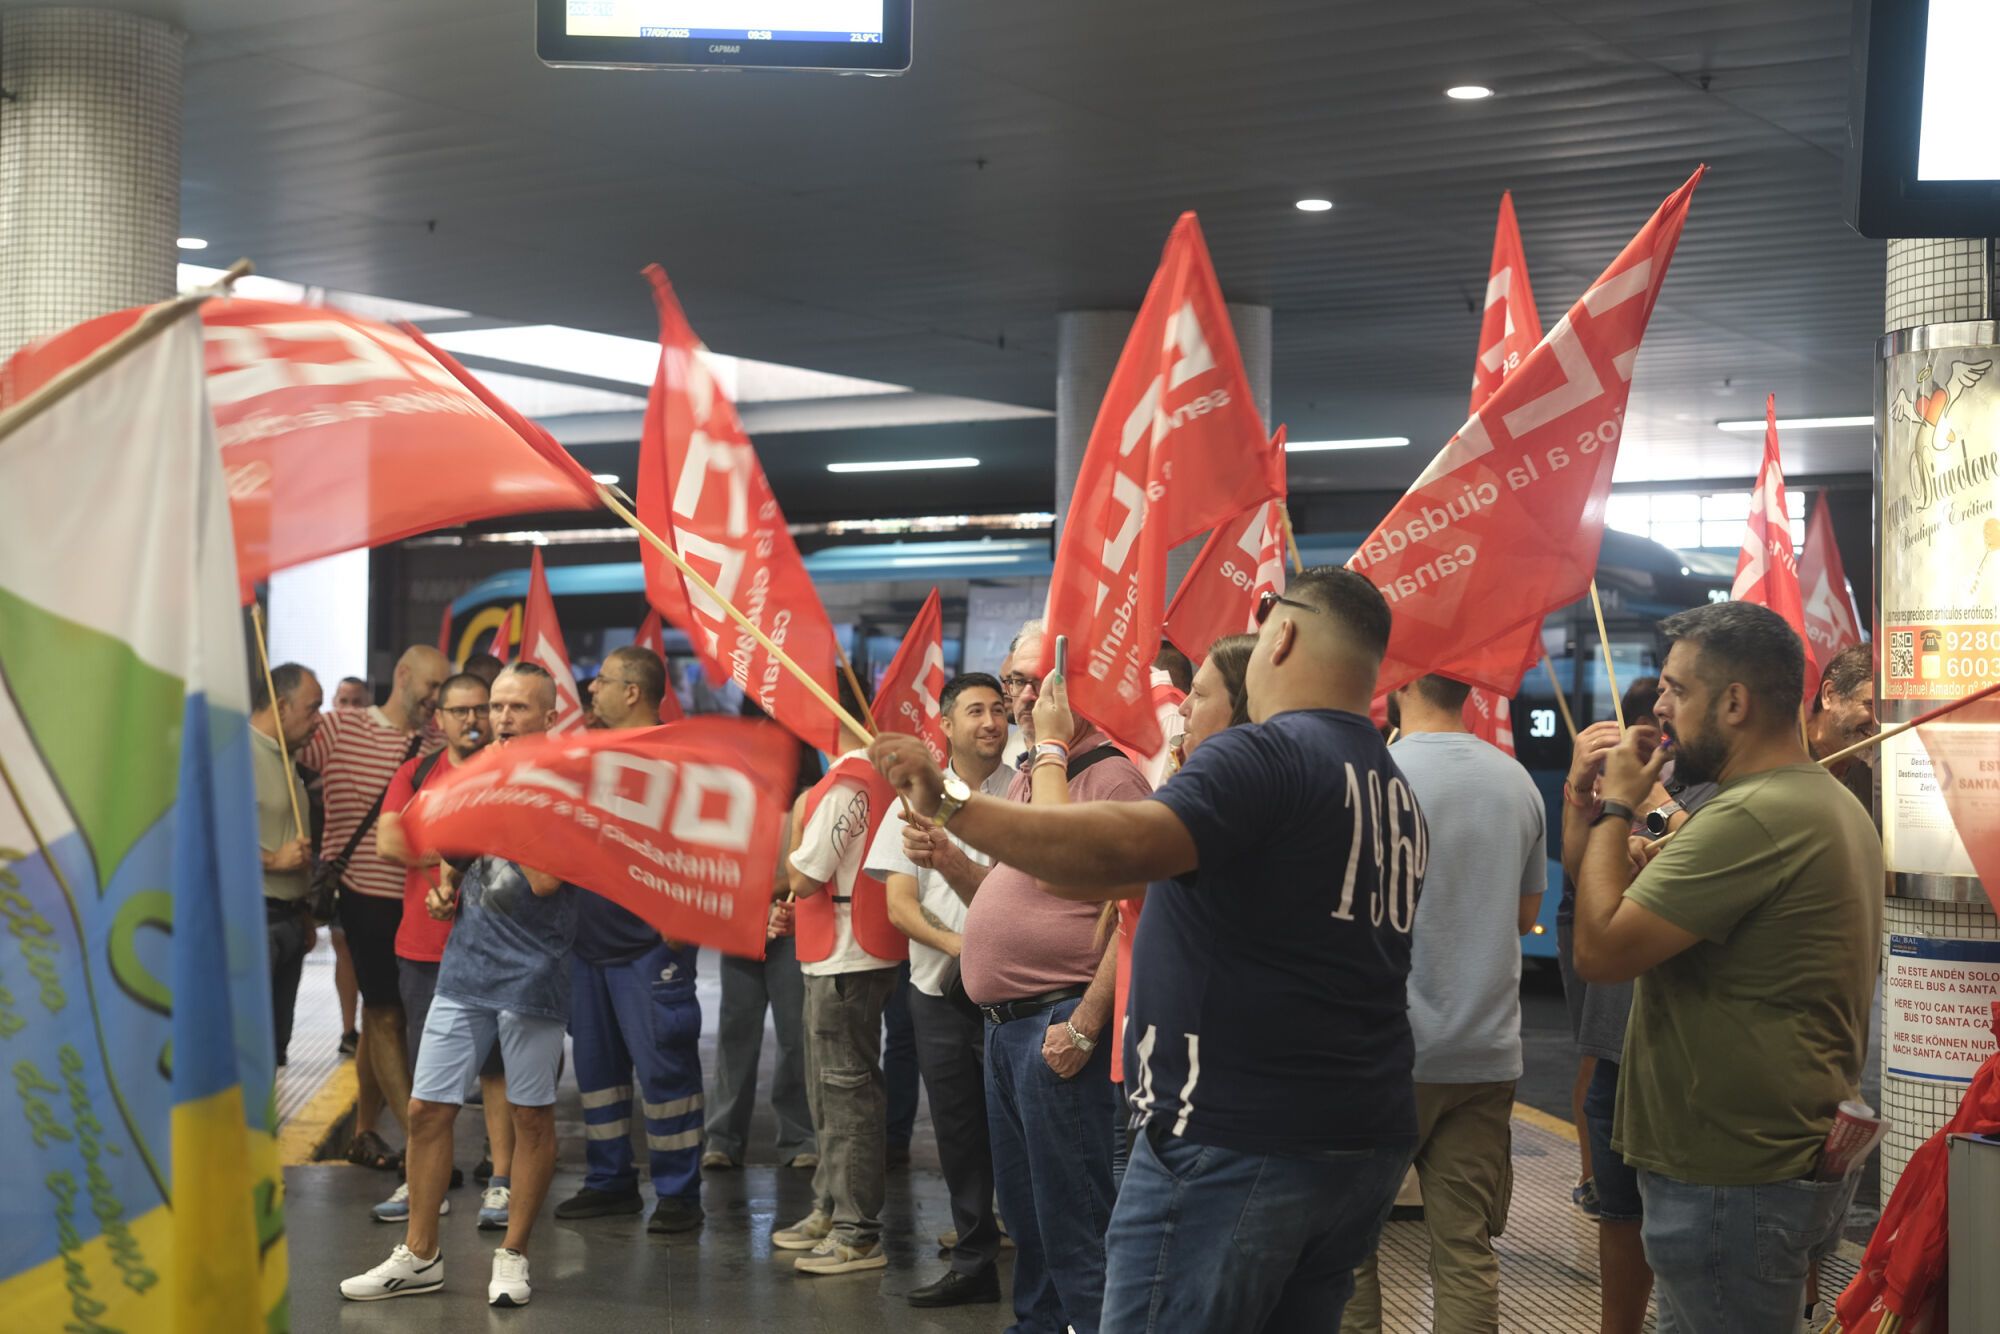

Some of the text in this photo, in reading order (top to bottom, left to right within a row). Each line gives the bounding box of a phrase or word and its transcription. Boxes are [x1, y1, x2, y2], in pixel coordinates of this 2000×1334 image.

[1929, 681, 1964, 696] Amador
[1530, 710, 1555, 737] 30
[1892, 935, 1918, 944] GLBAL
[1897, 965, 1999, 982] EN ESTE ANDÉN SOLO
[1890, 977, 1997, 995] COGER EL BUS A SANTA
[1894, 998, 1988, 1016] HERE YOU CAN TAKE
[1904, 1012, 1919, 1023] BUS
[1921, 1014, 1933, 1024] TO
[1935, 1016, 1970, 1028] SANTA
[1894, 1031, 1996, 1050] HIER SIE KÖNNEN NUR
[1892, 1044, 1912, 1055] NACH
[1913, 1046, 1942, 1060] SANTA
